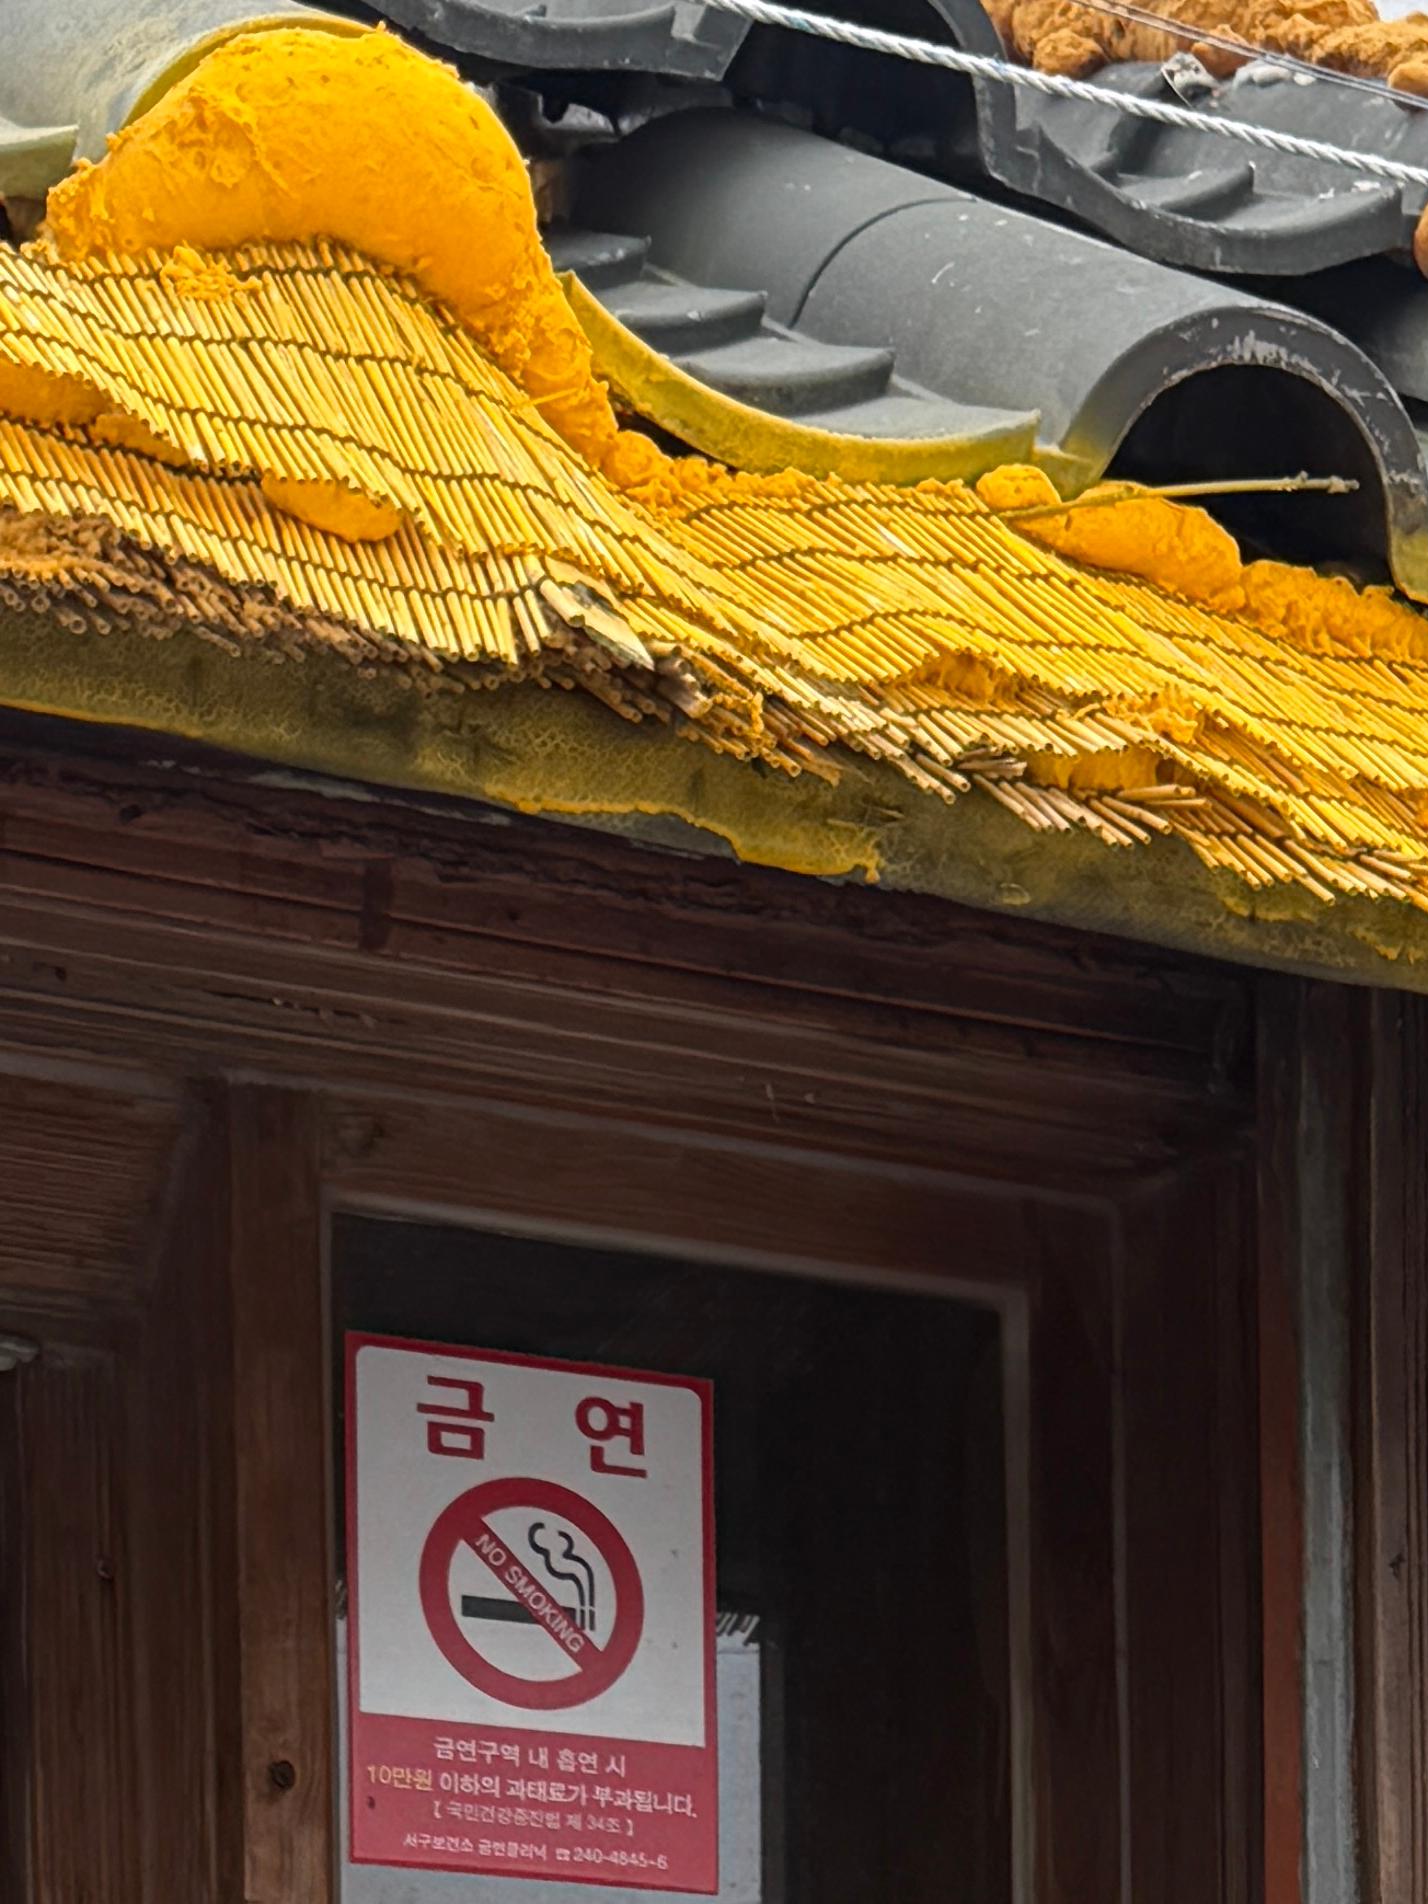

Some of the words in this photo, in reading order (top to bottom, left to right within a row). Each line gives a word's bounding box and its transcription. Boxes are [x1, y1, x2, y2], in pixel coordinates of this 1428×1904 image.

[475, 1533, 507, 1566] NO
[505, 1566, 585, 1653] SMOKING
[432, 1736, 521, 1768] 금연구역
[528, 1745, 548, 1769] 내
[556, 1747, 598, 1775] 흡연
[605, 1754, 627, 1778] 시
[367, 1764, 433, 1793] 10만원
[439, 1773, 500, 1798] 이하의
[505, 1778, 588, 1806] 과태료가
[594, 1785, 698, 1818] 부과됩니다.
[403, 1831, 474, 1854] 서구보건소
